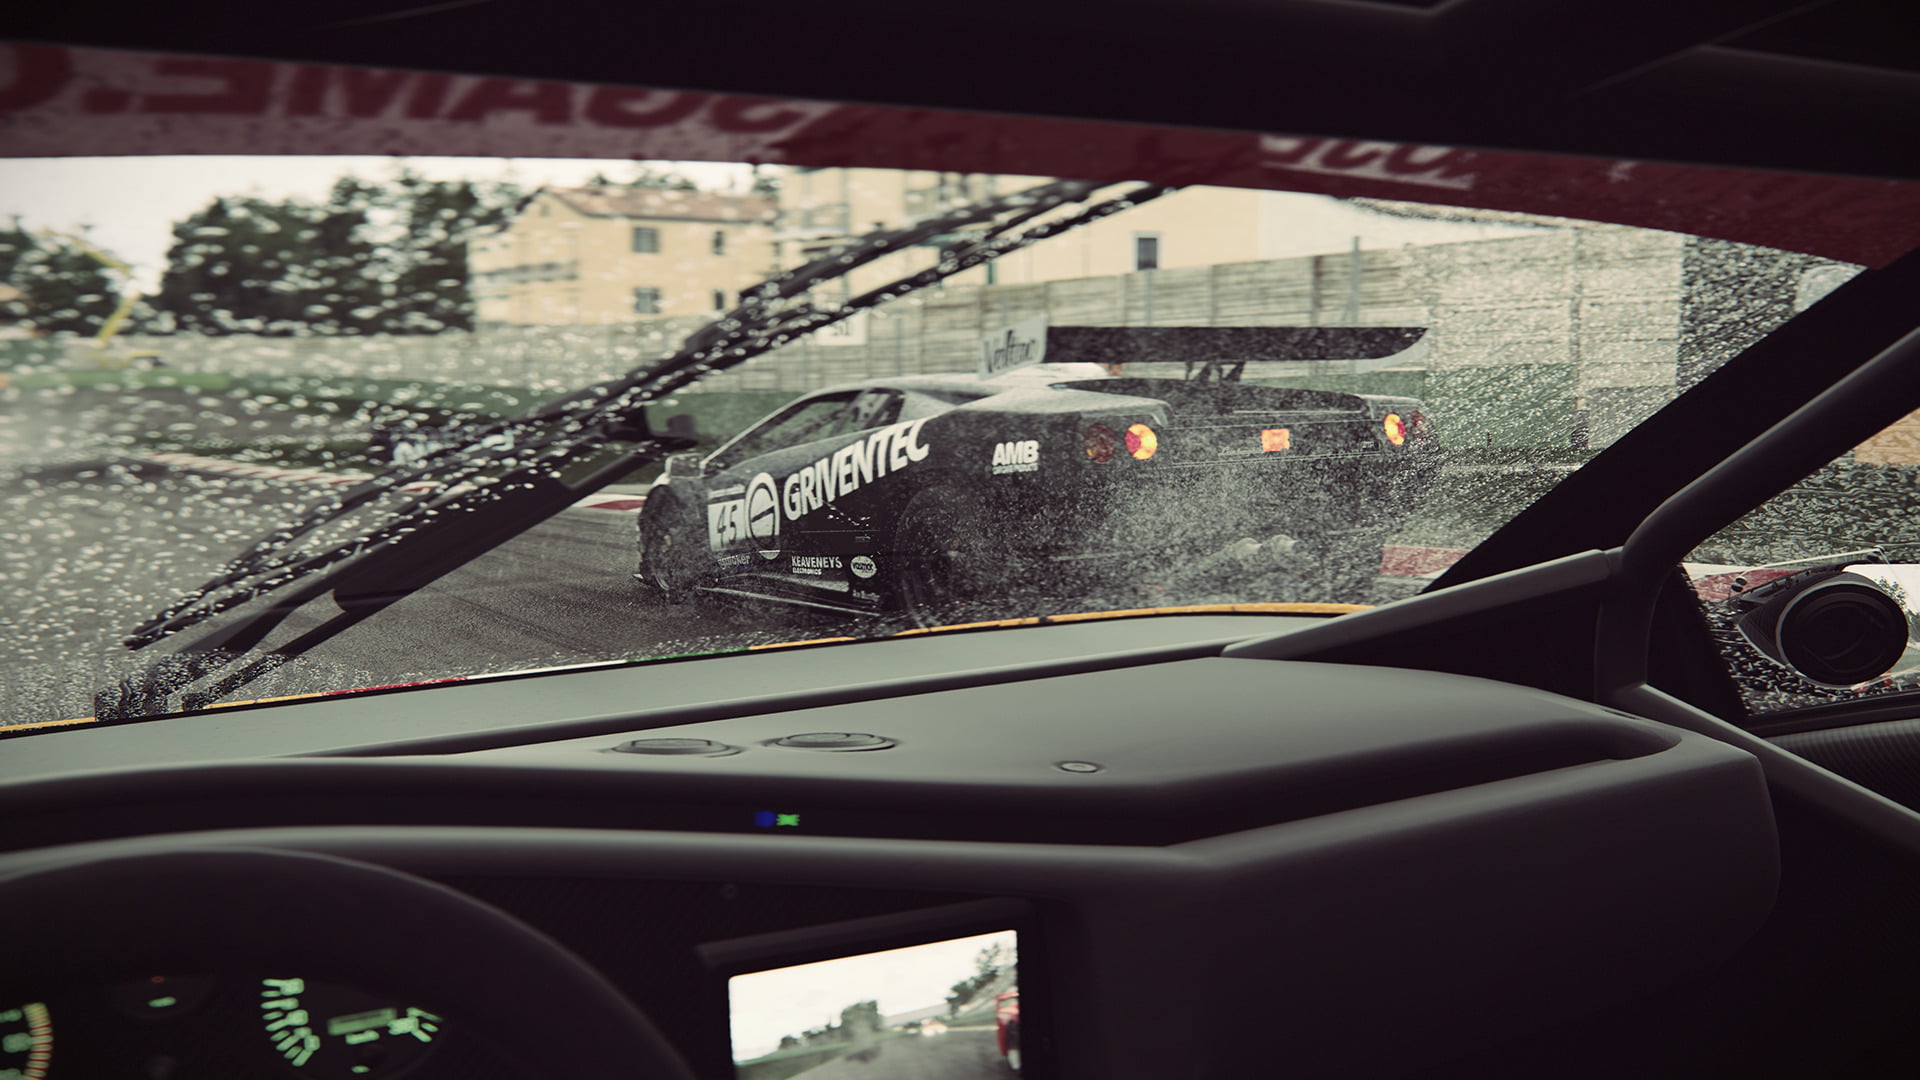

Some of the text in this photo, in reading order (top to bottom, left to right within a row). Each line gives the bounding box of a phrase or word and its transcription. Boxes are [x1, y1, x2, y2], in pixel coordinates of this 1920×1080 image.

[783, 418, 930, 521] GRIVENTEC
[992, 440, 1040, 466] AMB
[717, 504, 738, 548] 45
[791, 555, 843, 569] KEAVENEYS
